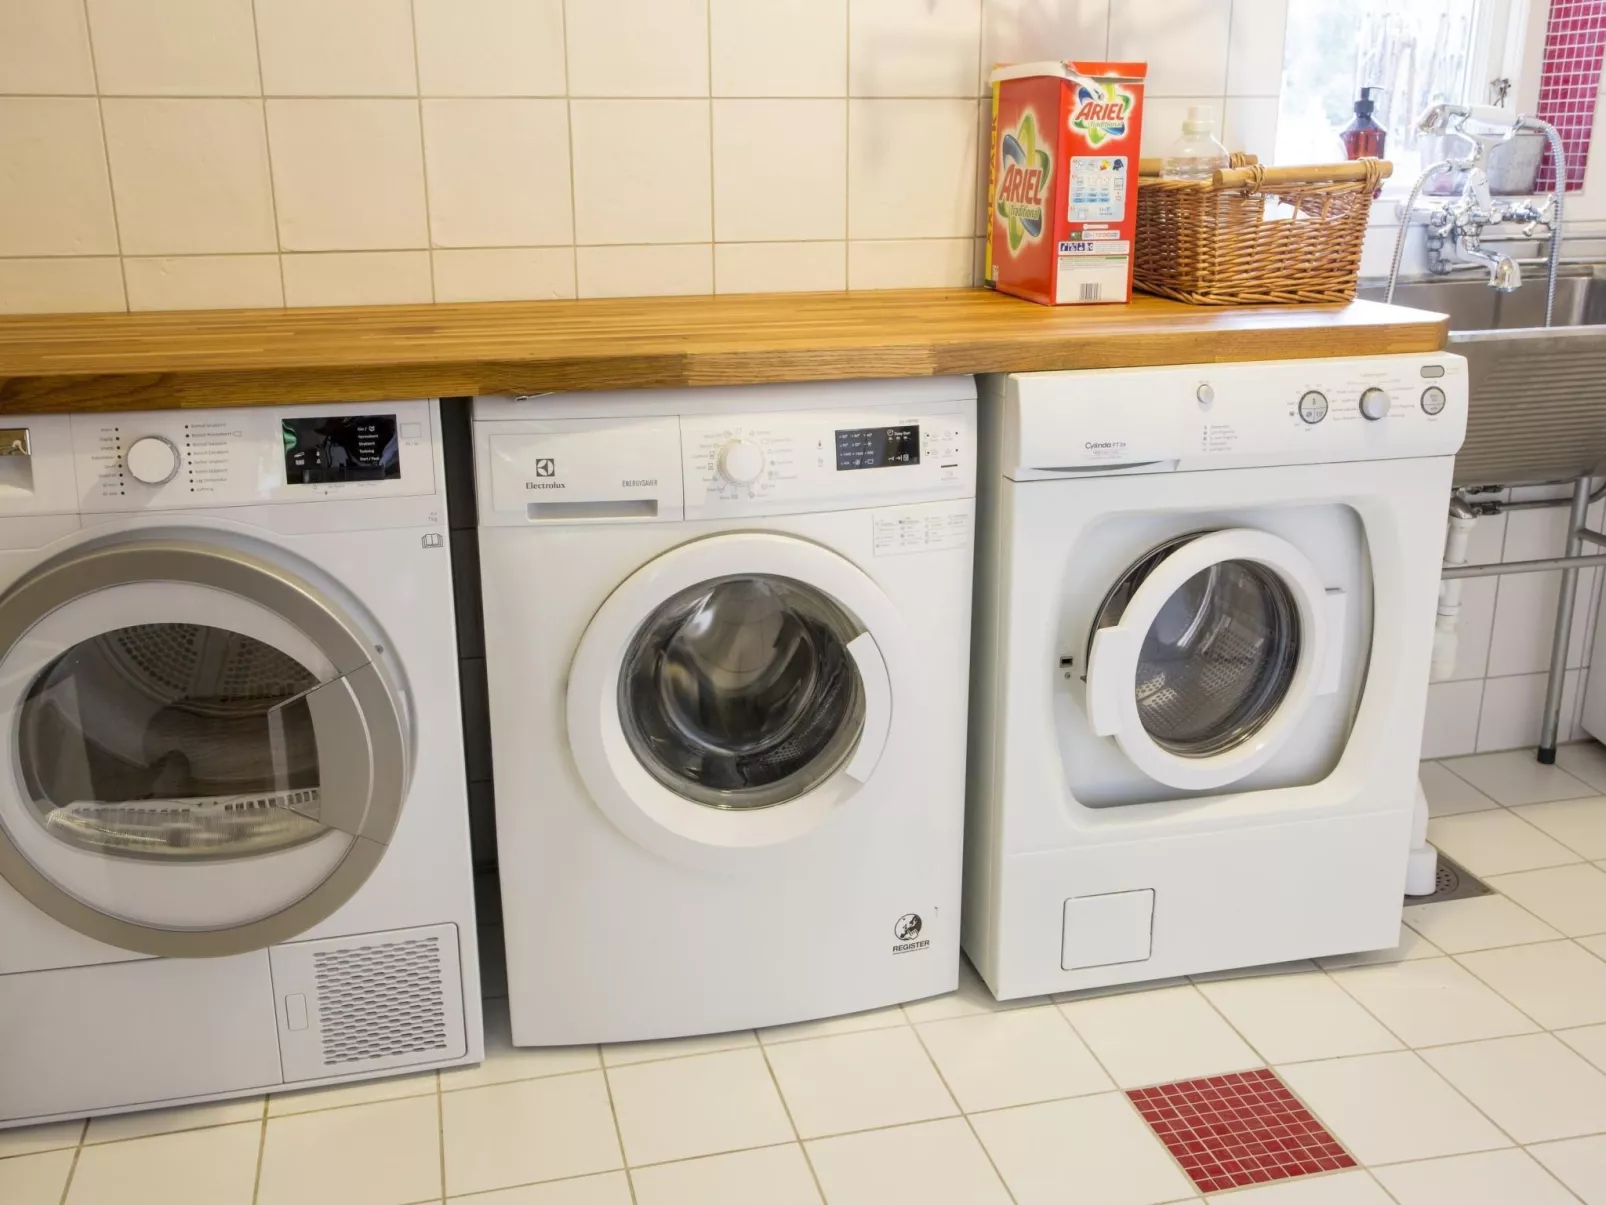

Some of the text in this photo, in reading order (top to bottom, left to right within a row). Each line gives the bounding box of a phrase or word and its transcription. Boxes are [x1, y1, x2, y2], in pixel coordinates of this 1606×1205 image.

[1075, 101, 1124, 121] ARIEL
[999, 163, 1042, 206] ARIEL
[525, 481, 566, 490] Electrolux
[622, 479, 659, 488] ENERGYSAVER
[892, 940, 930, 952] REGISTER
